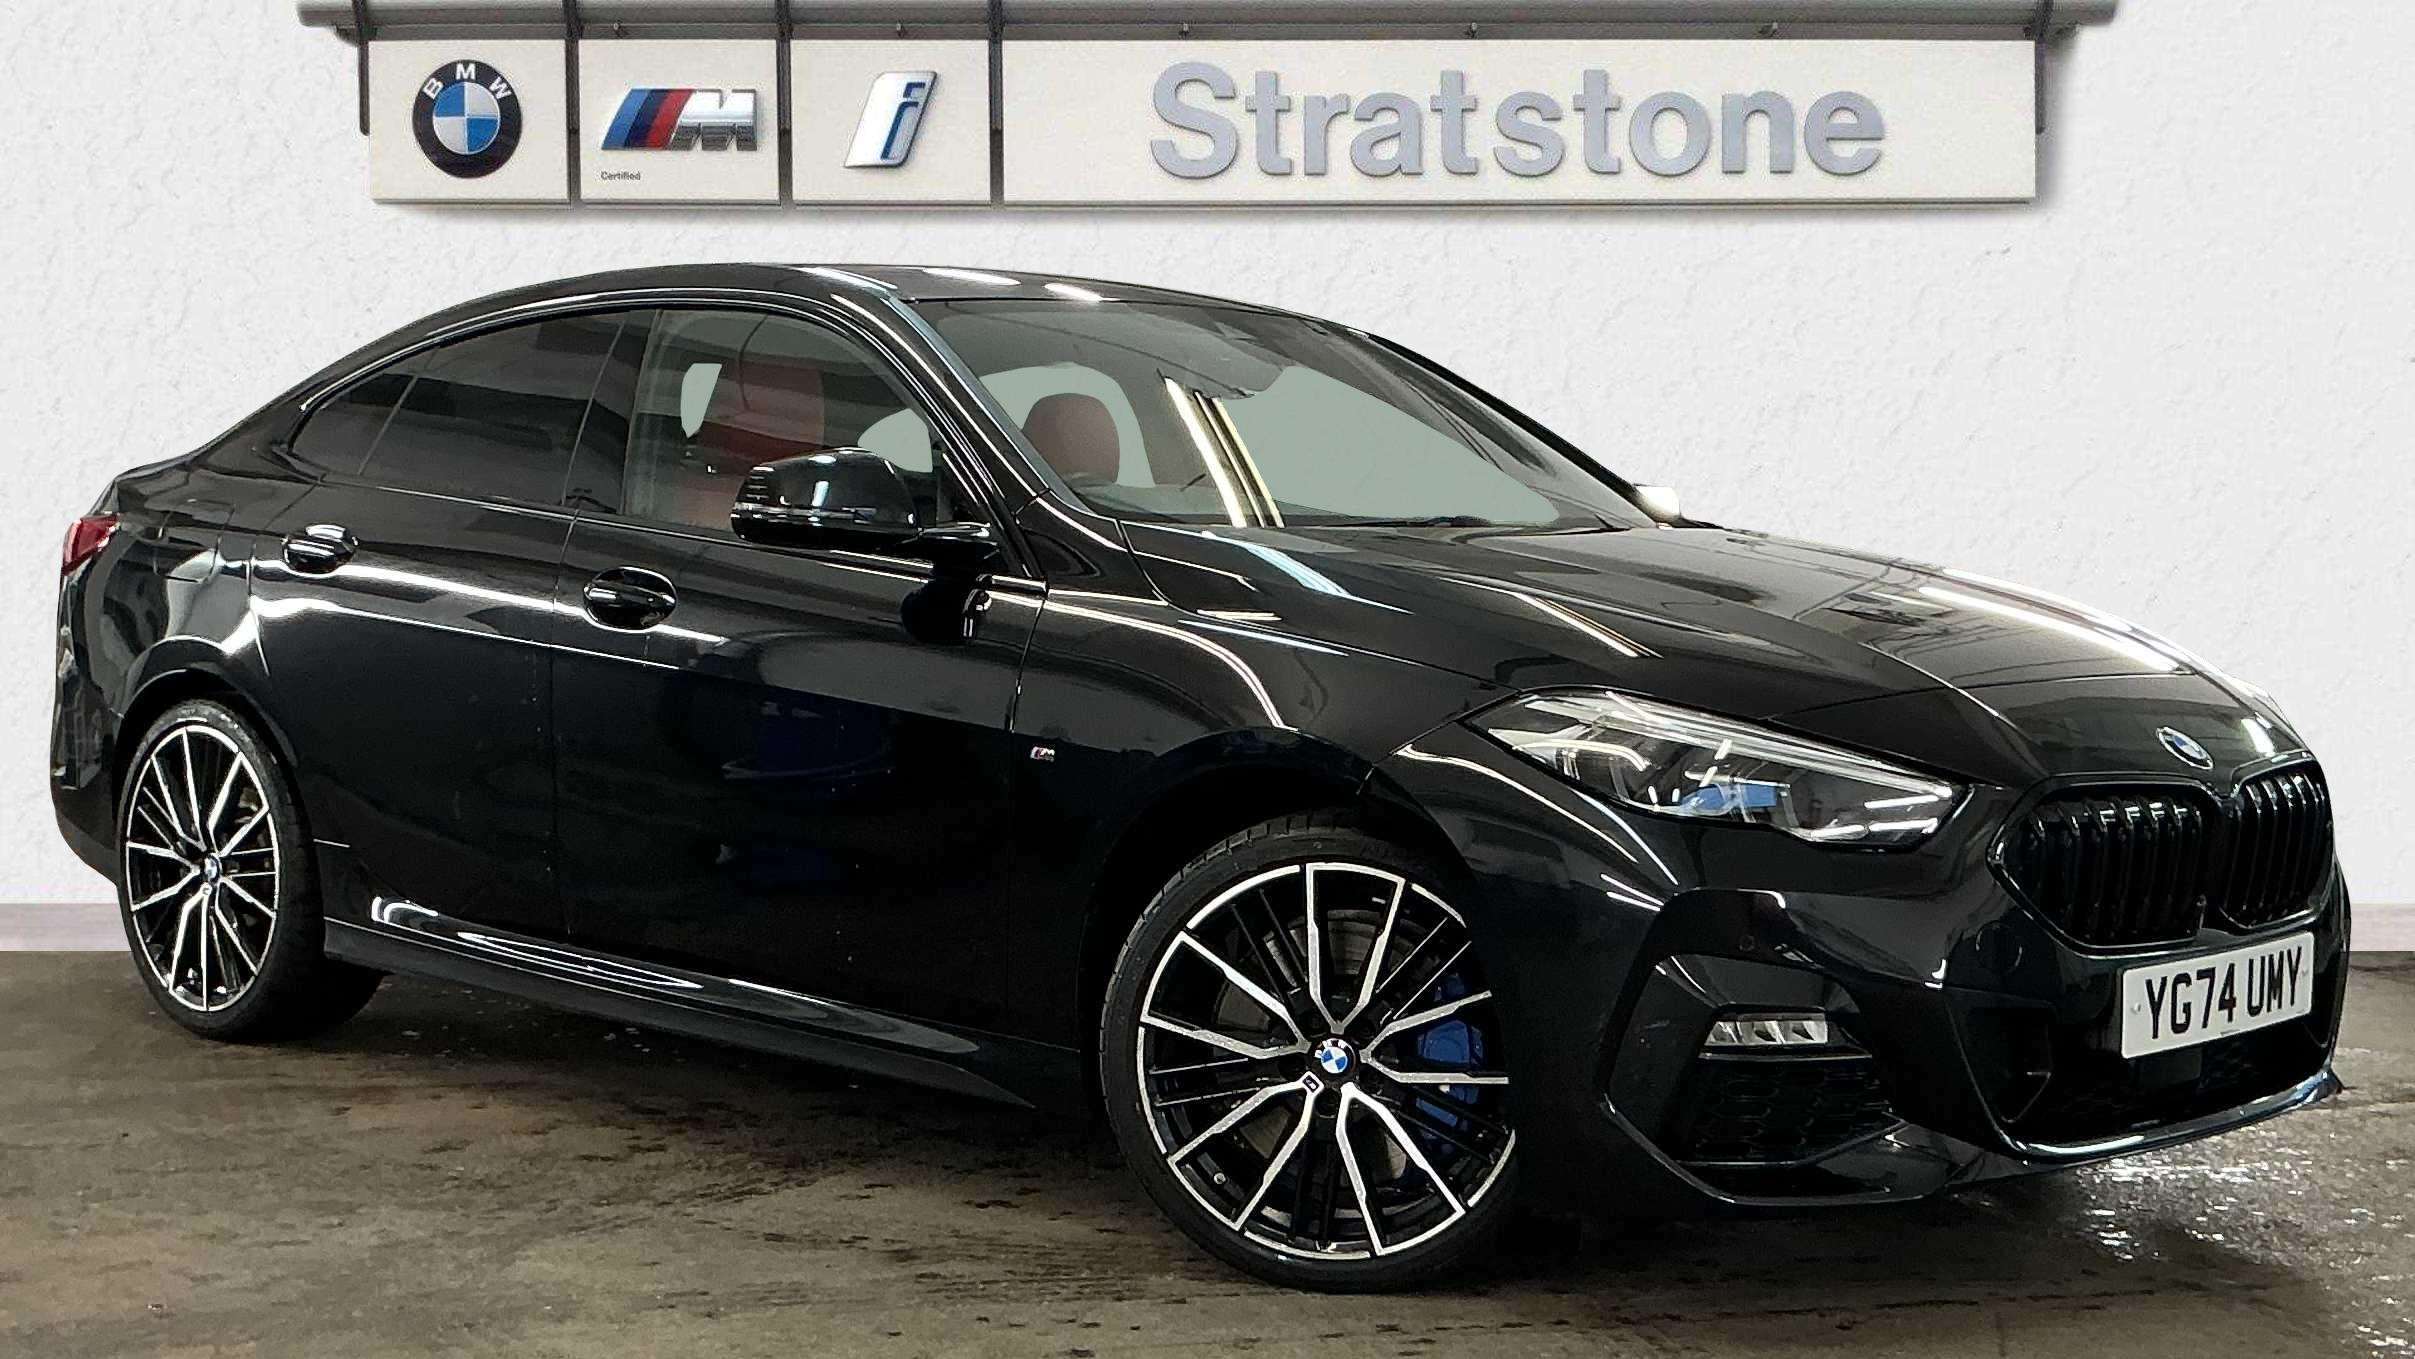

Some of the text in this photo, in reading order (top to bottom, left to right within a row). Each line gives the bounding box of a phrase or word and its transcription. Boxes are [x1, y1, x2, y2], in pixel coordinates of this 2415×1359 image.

[423, 63, 512, 100] BMW
[1151, 61, 1886, 179] Stratstone
[600, 171, 642, 181] Certified
[2145, 946, 2303, 1039] YG74 UMY
